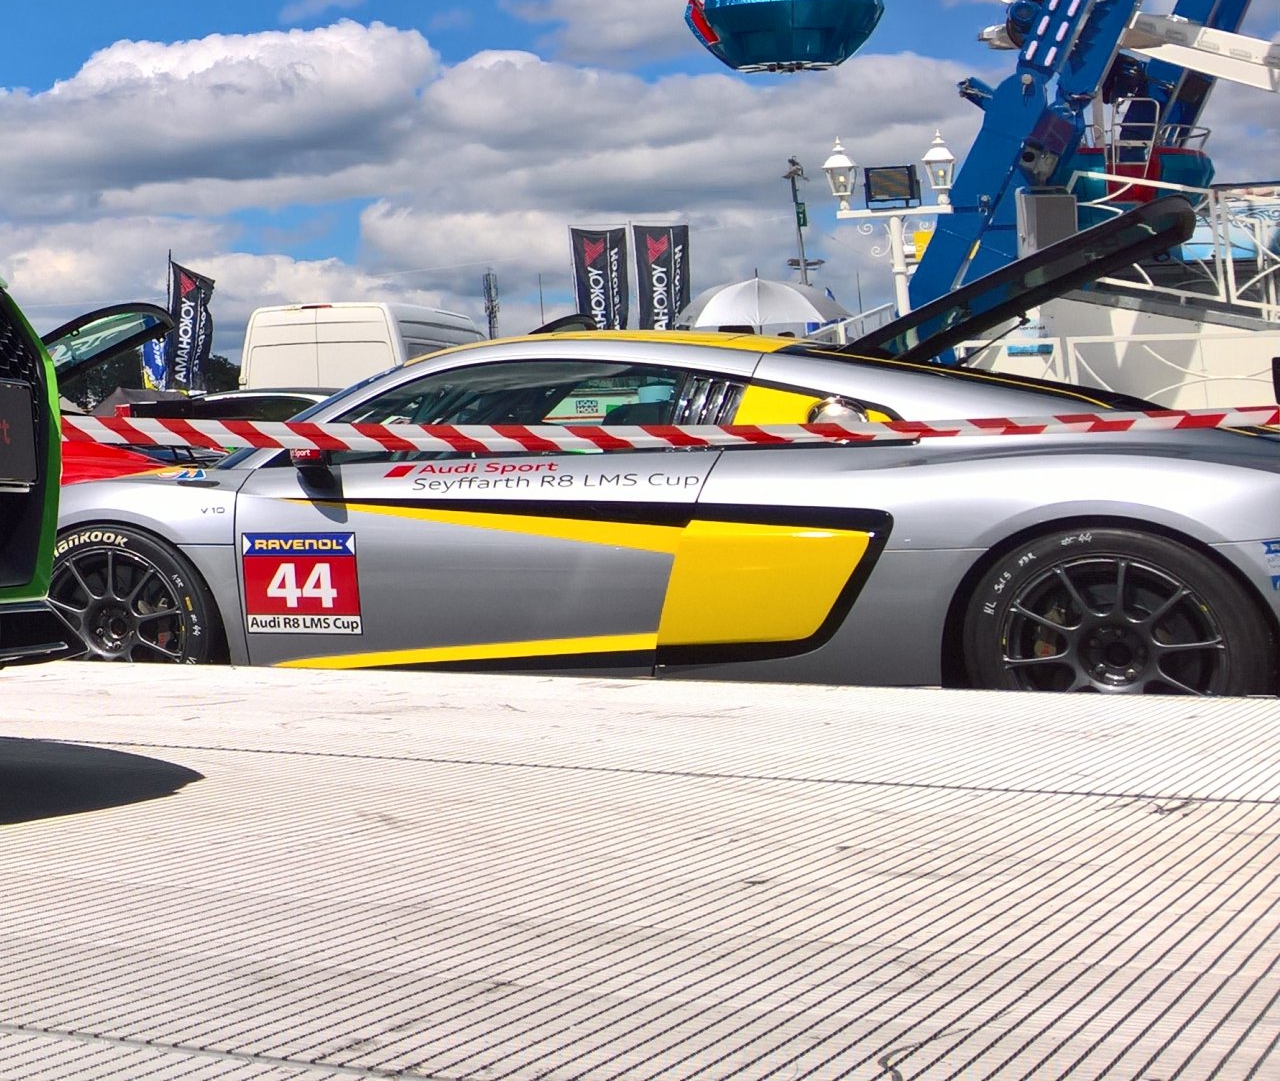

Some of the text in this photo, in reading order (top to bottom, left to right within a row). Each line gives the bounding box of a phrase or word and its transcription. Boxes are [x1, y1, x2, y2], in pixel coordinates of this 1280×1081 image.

[418, 461, 559, 475] Audi Sport
[412, 473, 699, 494] Seyffarth R8 LMS Cup
[254, 539, 343, 550] RAVENOL
[266, 562, 338, 608] 44
[250, 617, 359, 632] Audi R8 LMS Cup
